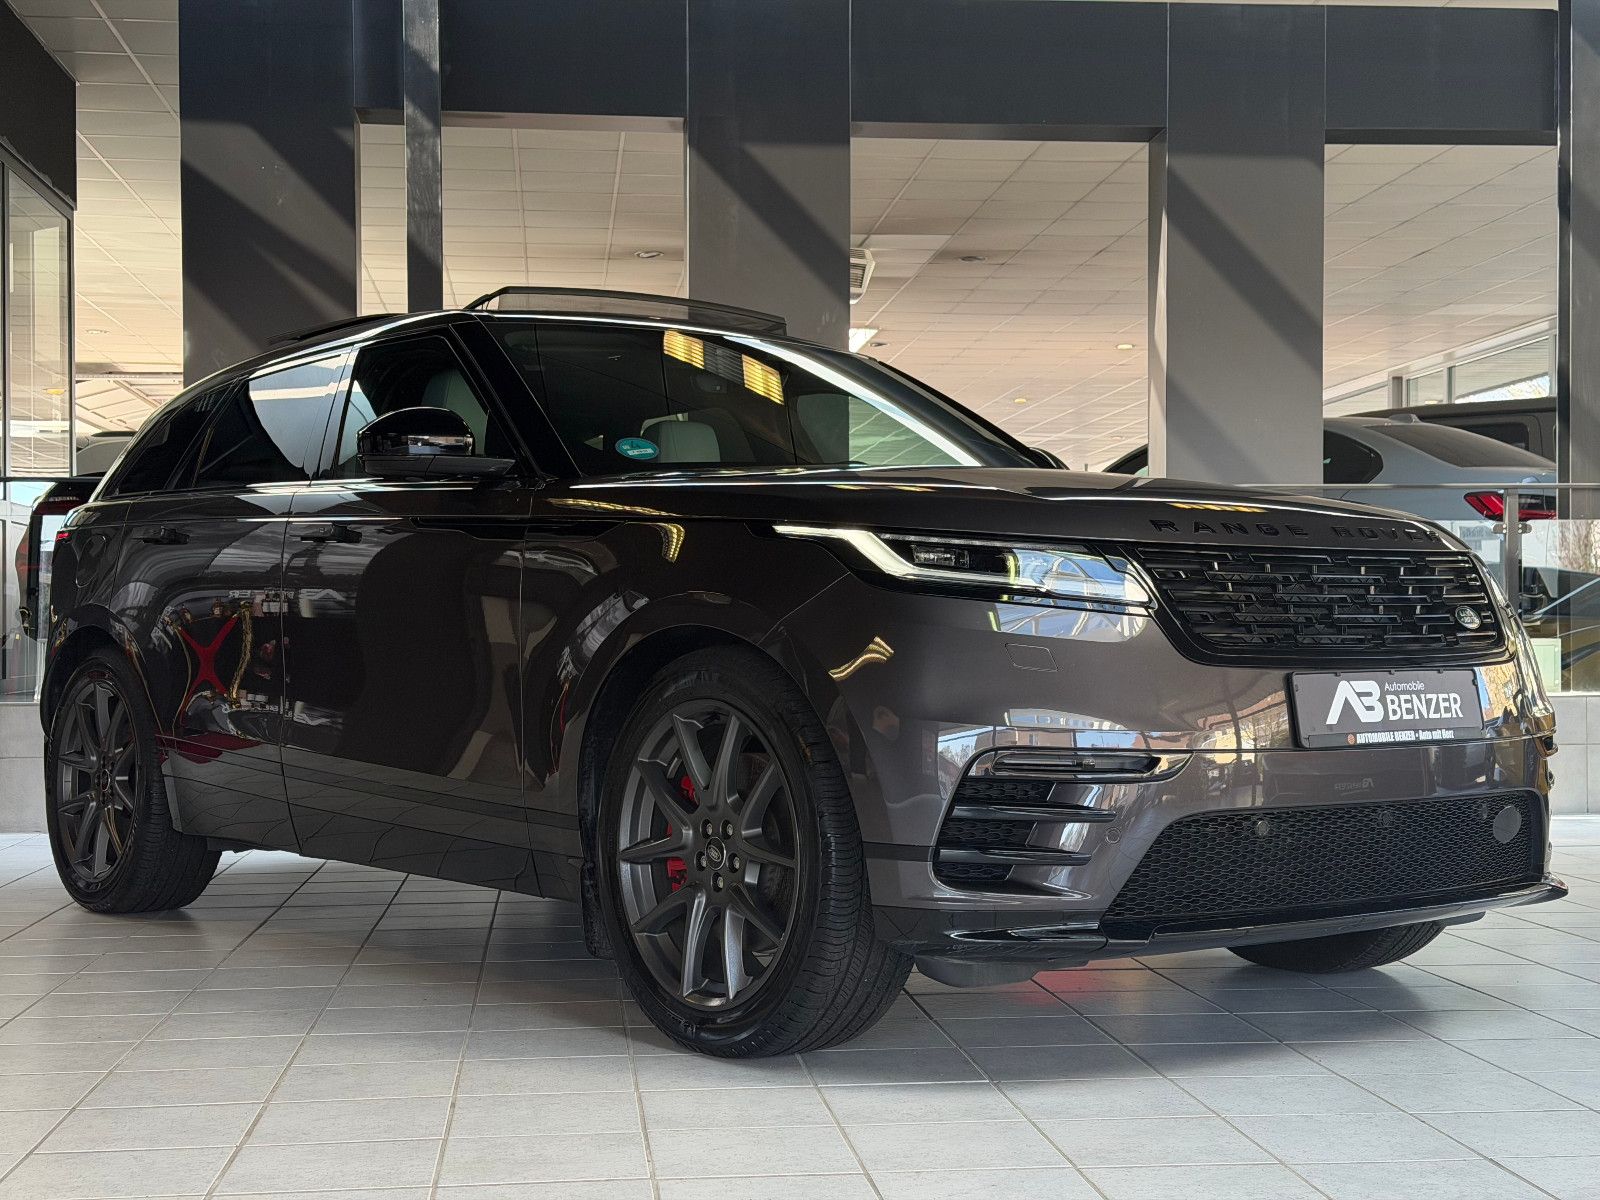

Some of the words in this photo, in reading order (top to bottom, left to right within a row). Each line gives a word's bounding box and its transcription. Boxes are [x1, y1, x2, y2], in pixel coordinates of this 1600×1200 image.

[1150, 519, 1309, 537] RANGE
[1384, 681, 1425, 692] Automobile
[1325, 680, 1385, 725] AB
[1385, 692, 1464, 721] BENZER
[1356, 732, 1395, 744] AUTOMOBILE
[1395, 731, 1416, 742] BENZER
